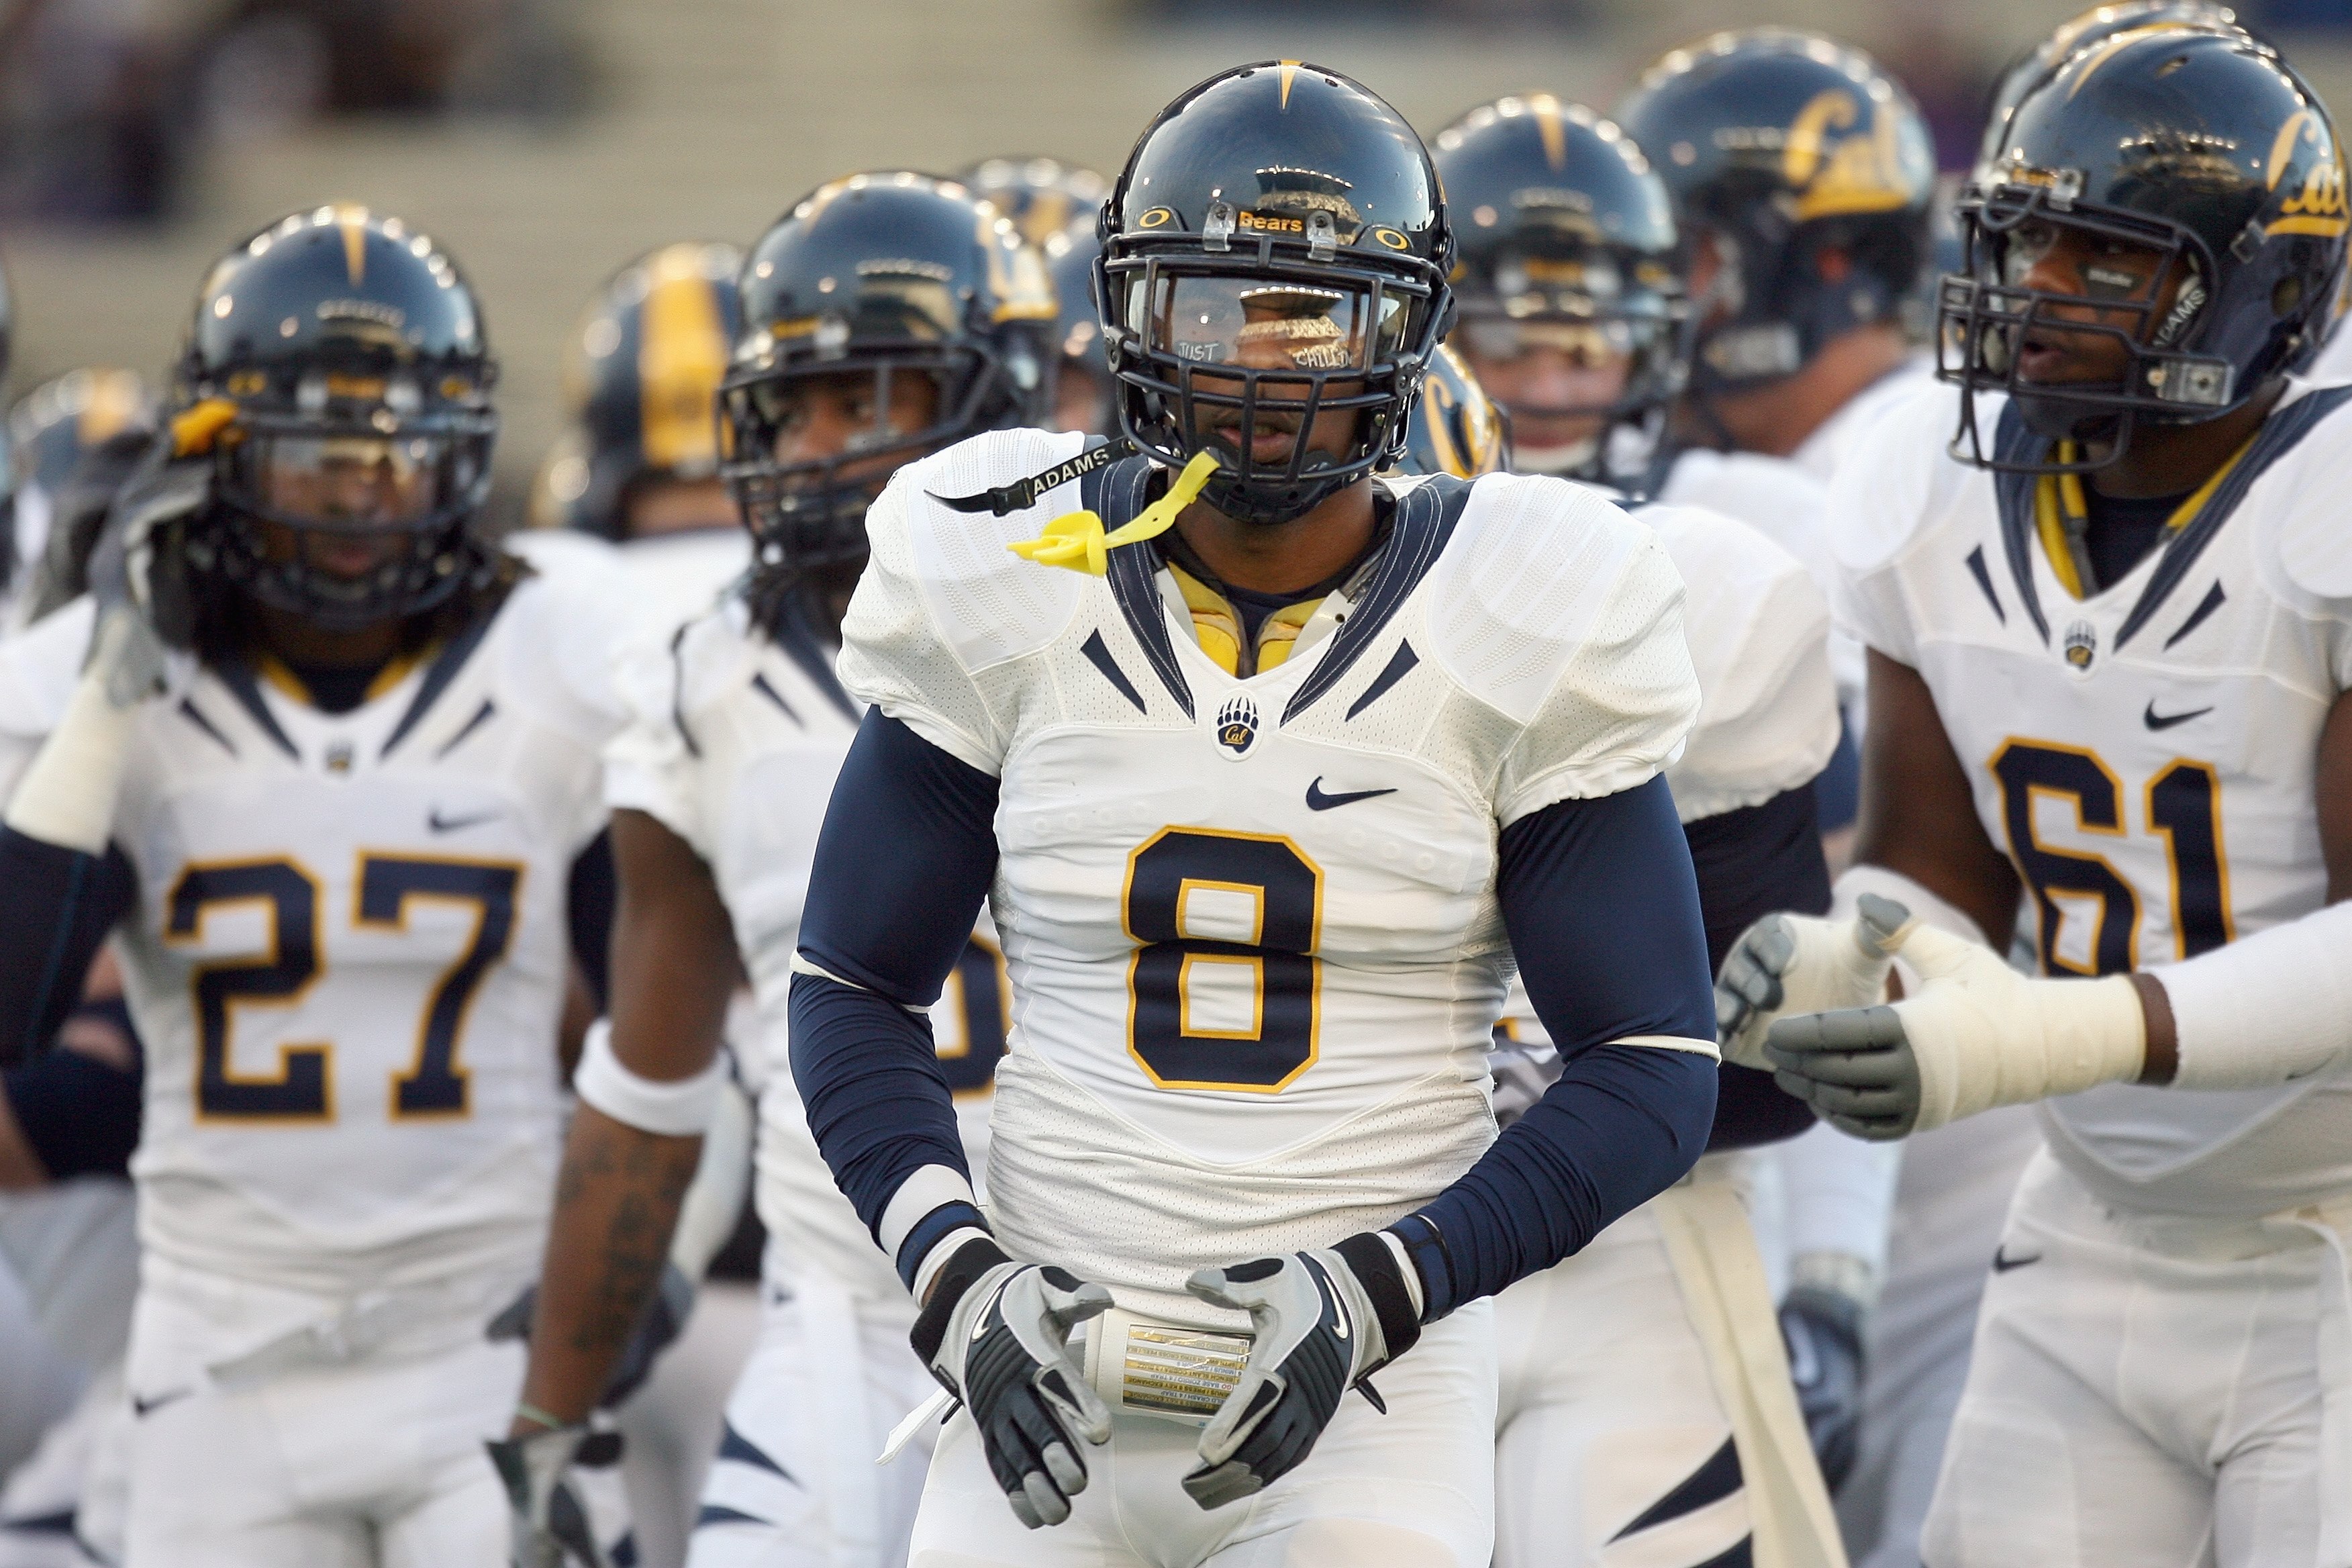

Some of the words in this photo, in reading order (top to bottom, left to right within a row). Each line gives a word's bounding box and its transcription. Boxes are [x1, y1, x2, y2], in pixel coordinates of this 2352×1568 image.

[1239, 211, 1303, 232] Bears
[1178, 342, 1219, 361] JUST
[1034, 448, 1109, 495] ADAMS
[1224, 725, 1248, 745] Cal
[1986, 735, 2235, 977] 61
[1121, 824, 1324, 1094] 8
[161, 848, 529, 1127] 27
[1128, 1377, 1163, 1387] EXCHANGE
[1187, 1393, 1210, 1402] CRASH
